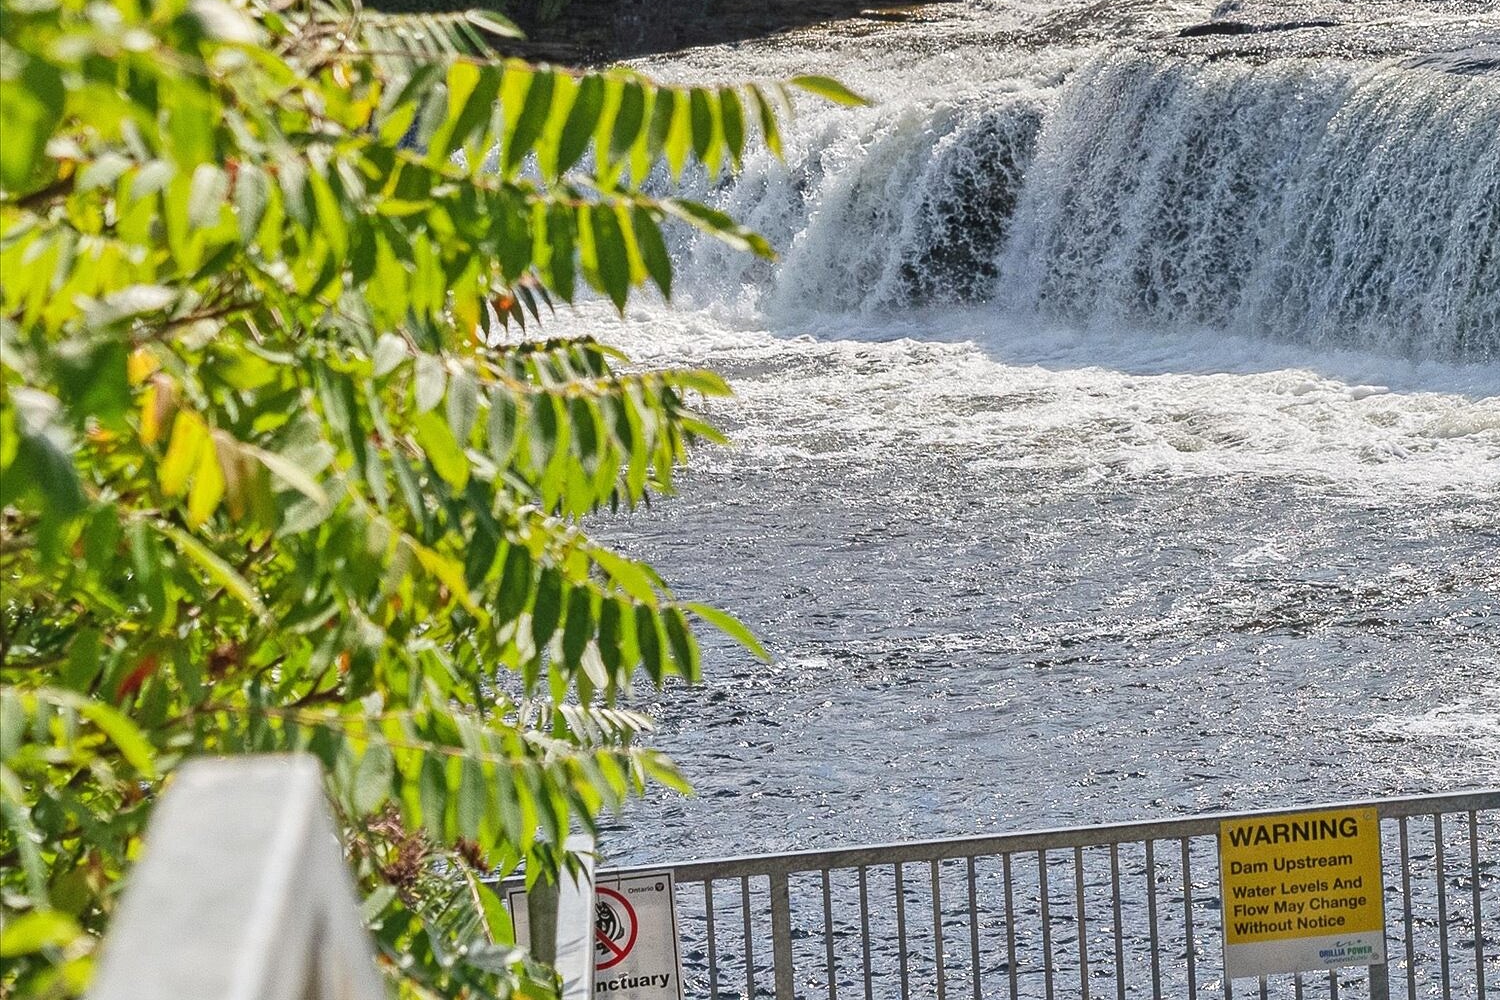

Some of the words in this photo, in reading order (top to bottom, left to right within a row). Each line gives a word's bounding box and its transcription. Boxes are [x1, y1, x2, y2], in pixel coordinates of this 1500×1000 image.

[1229, 817, 1358, 847] WARNING
[1230, 861, 1268, 875] Dam
[1273, 854, 1353, 873] Upstream
[628, 886, 654, 894] Ontario
[1232, 884, 1277, 899] Water
[1281, 880, 1328, 895] Levels
[1333, 876, 1363, 890] And
[1234, 904, 1269, 917] Flow
[1274, 900, 1305, 914] May
[1309, 895, 1367, 910] Change
[1234, 920, 1293, 935] Without
[1297, 916, 1346, 930] Notice
[1319, 948, 1345, 958] ORILLIA
[1347, 945, 1373, 955] POWER
